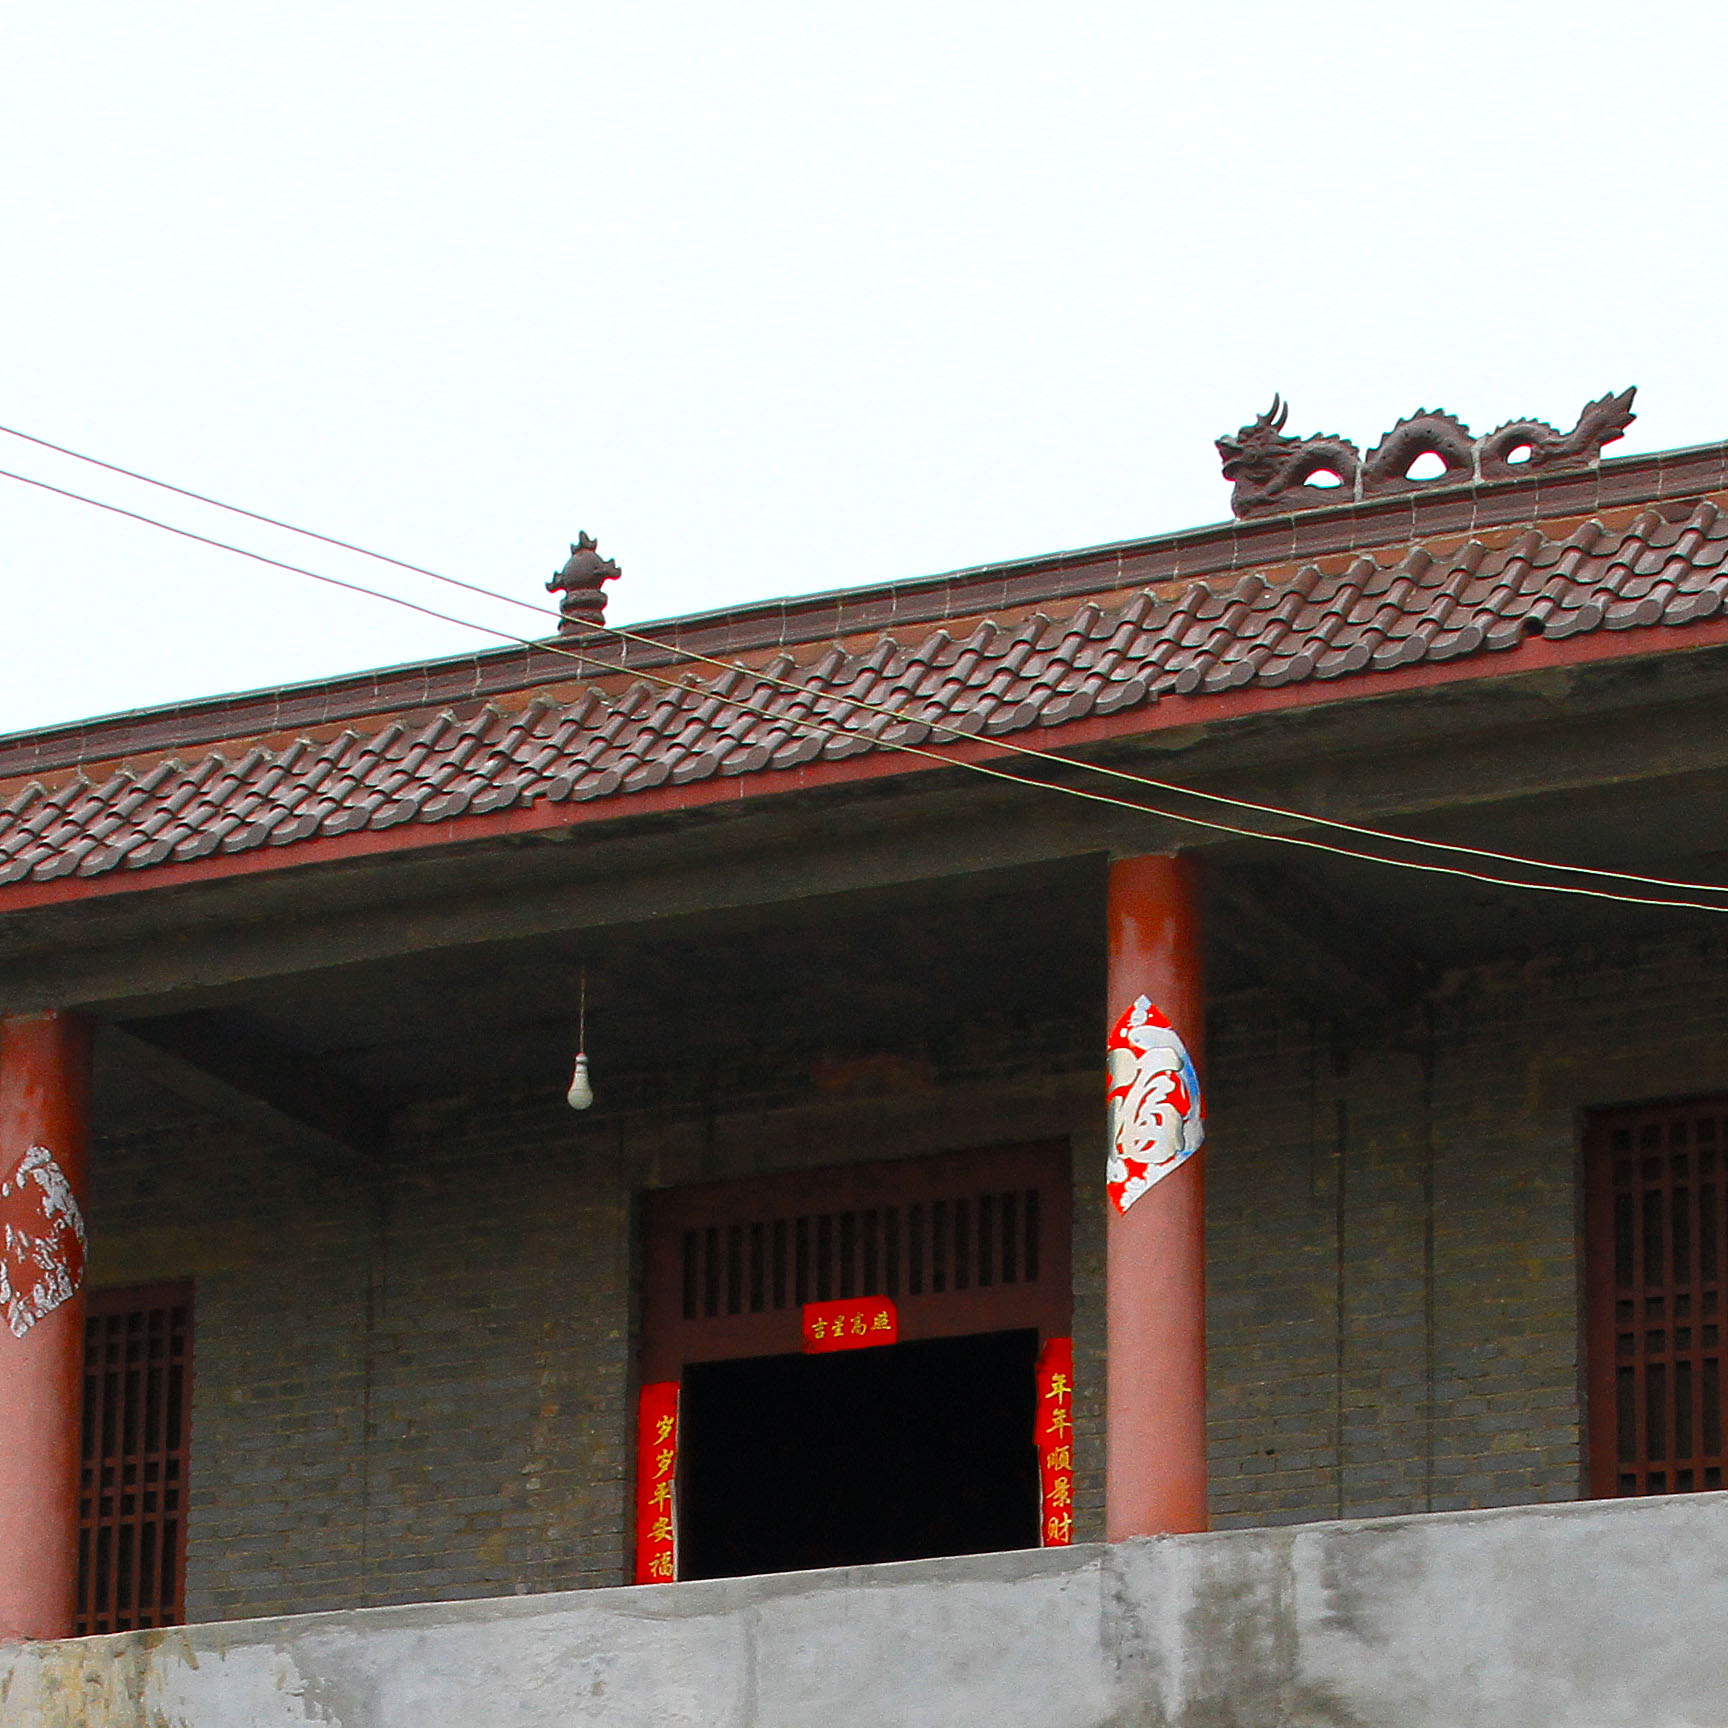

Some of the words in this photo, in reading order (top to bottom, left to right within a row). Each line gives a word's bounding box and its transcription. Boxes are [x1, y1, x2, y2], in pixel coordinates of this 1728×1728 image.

[812, 1310, 892, 1339] 吉星高照
[646, 1414, 675, 1578] 岁岁平安福
